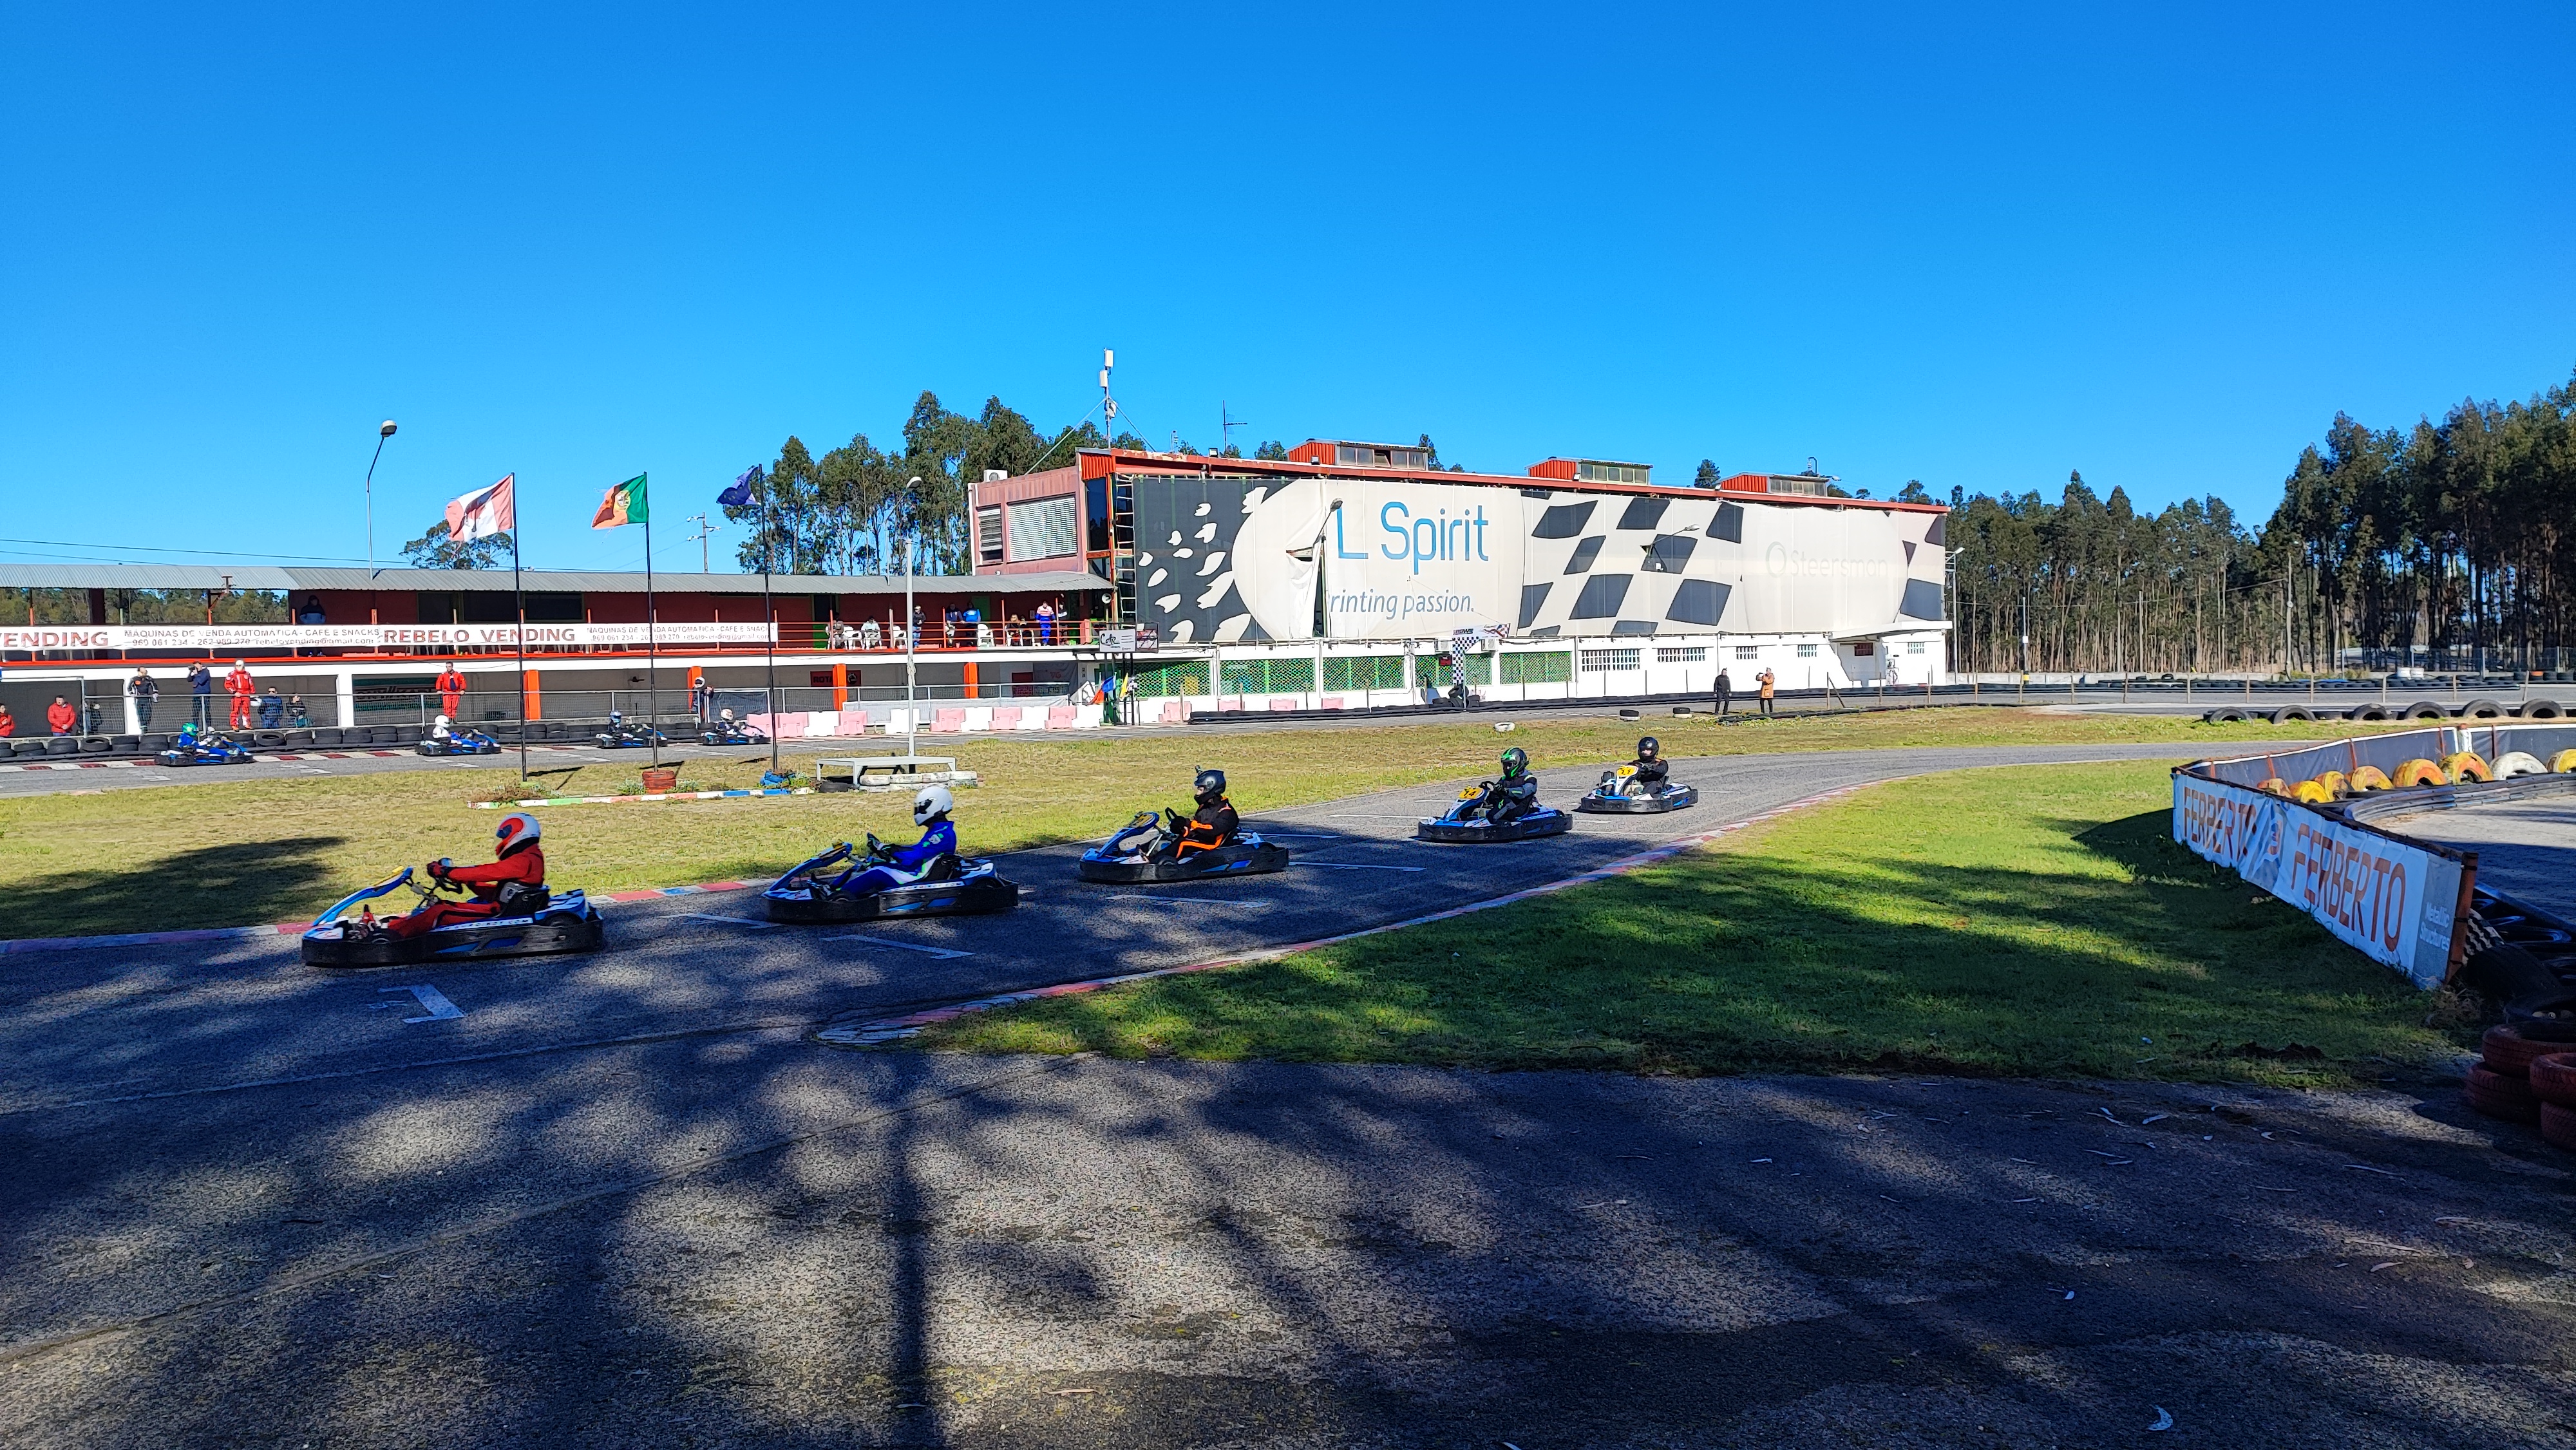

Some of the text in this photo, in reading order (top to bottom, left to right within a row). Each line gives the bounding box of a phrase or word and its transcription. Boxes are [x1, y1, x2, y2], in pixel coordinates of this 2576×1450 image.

[1381, 502, 1489, 575] Spirit
[1330, 588, 1475, 620] rinting passion.
[0, 632, 108, 647] ENDING
[384, 628, 575, 643] REBELO VENDING
[2291, 823, 2406, 952] FERBERTO
